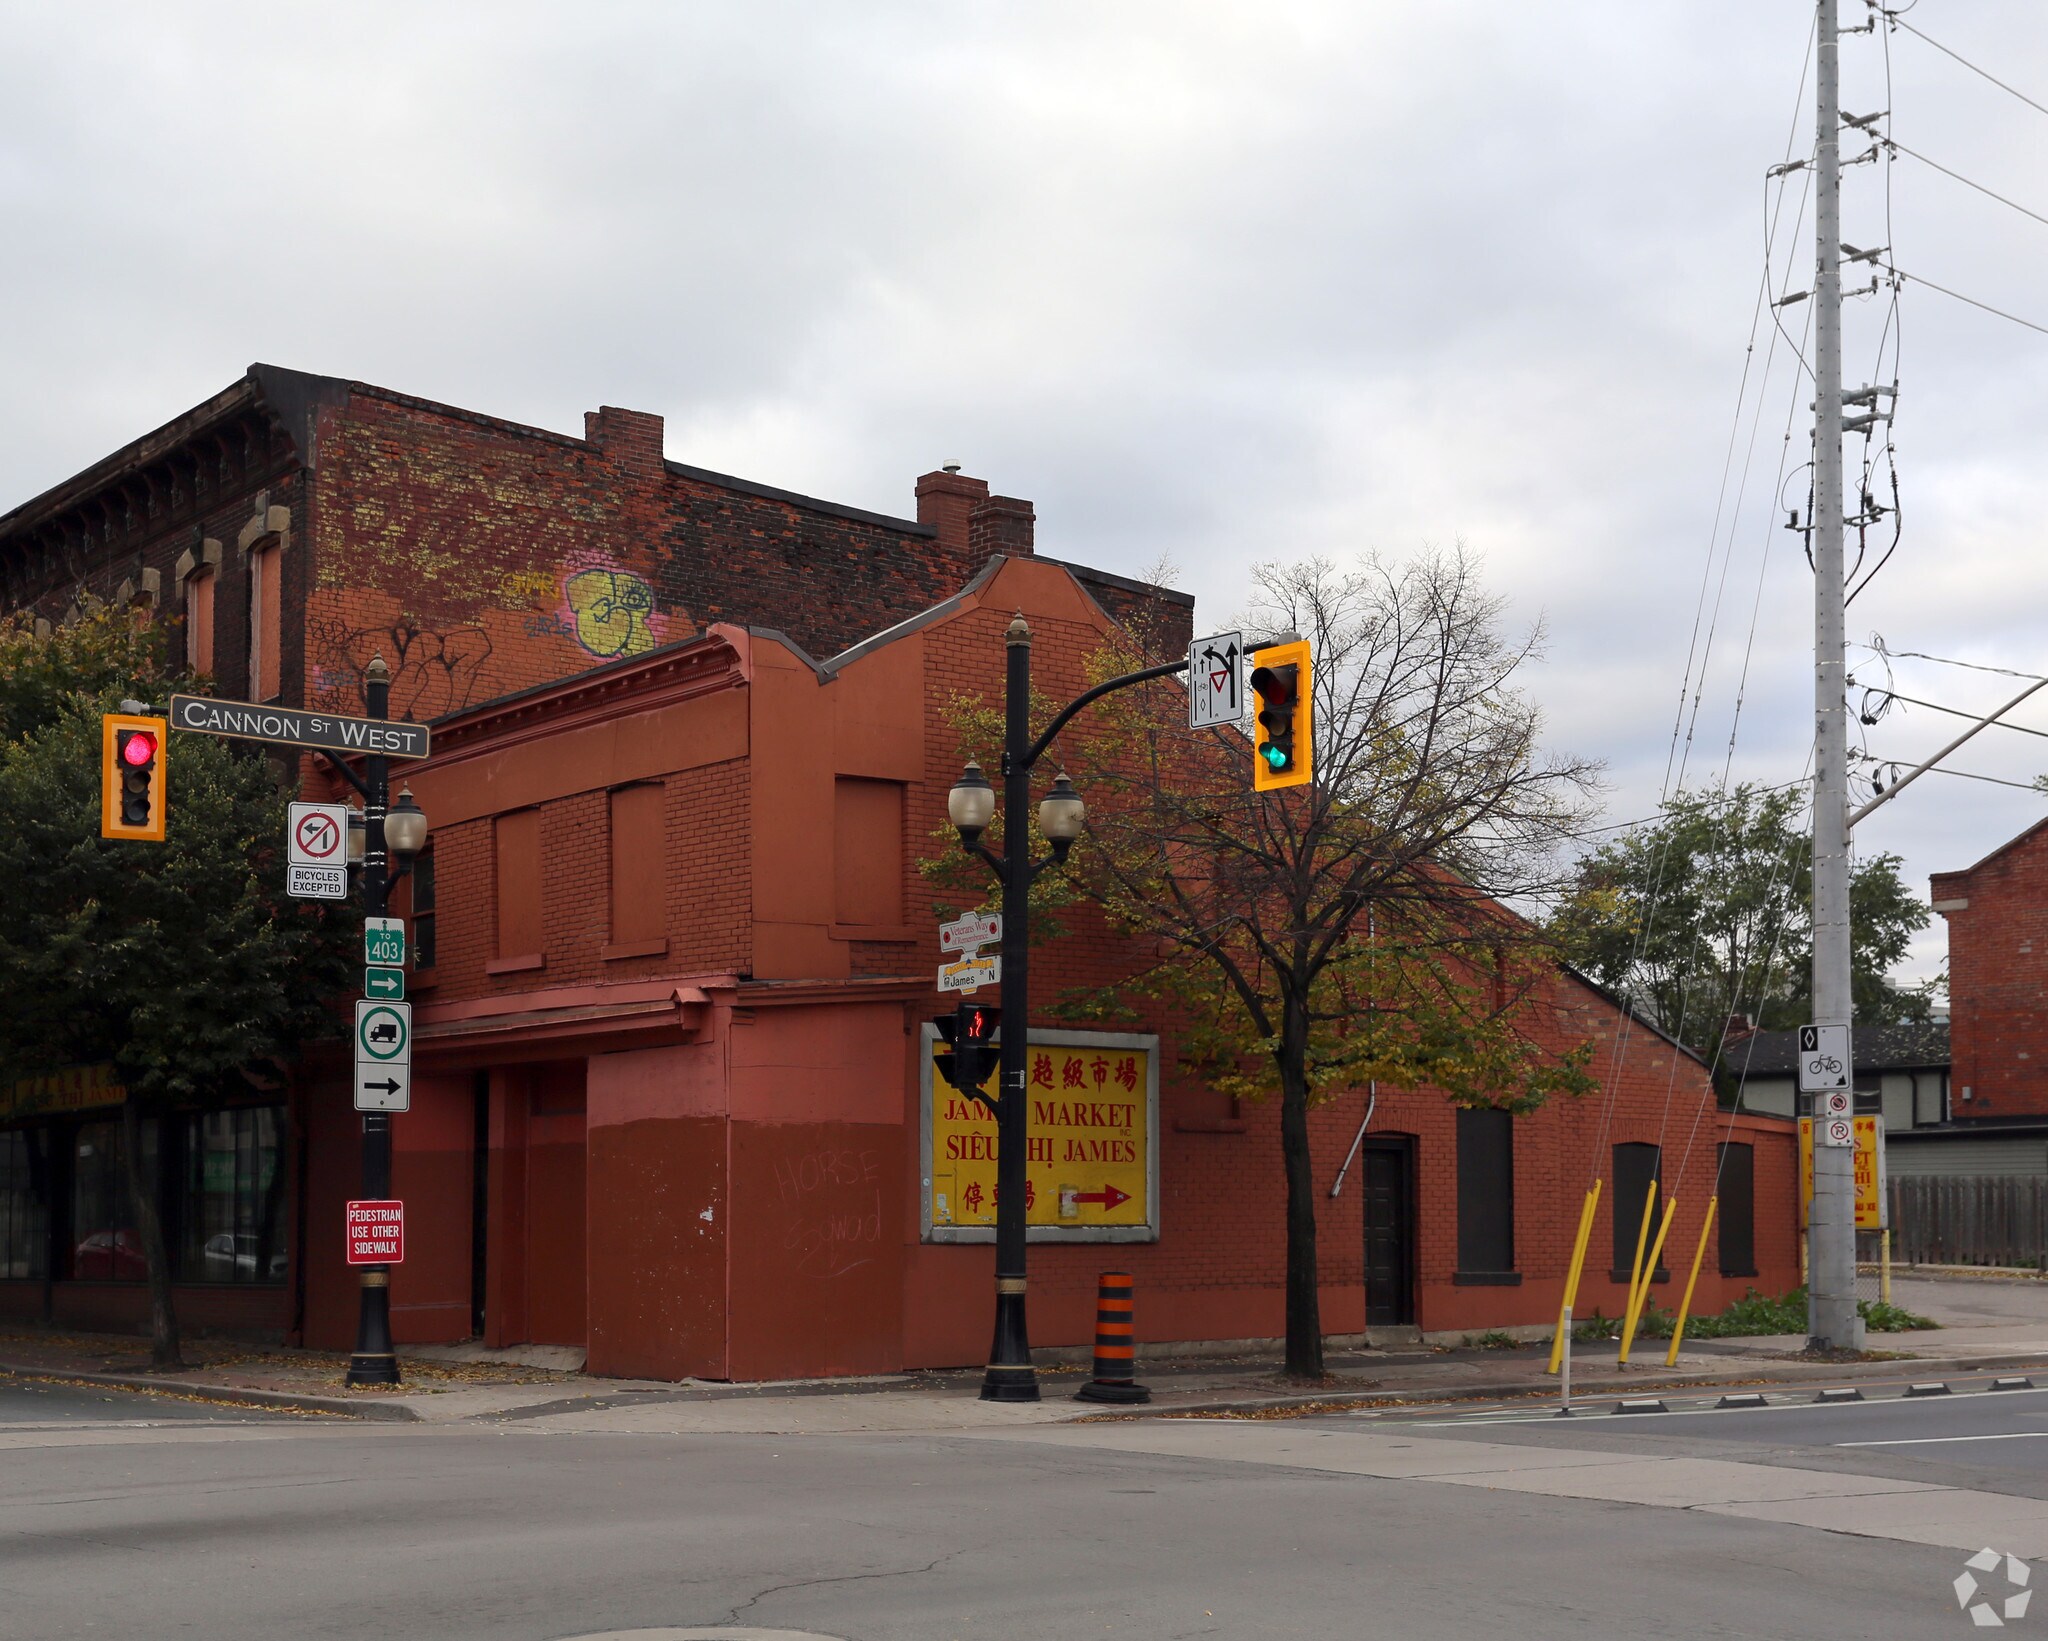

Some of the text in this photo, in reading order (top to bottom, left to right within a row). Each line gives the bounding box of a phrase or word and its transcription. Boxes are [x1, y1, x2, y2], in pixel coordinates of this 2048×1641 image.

[184, 702, 300, 739] CANNON
[339, 721, 417, 751] WEST
[295, 870, 340, 882] BICYCLES
[293, 881, 341, 893] EXCEPTED
[950, 921, 988, 936] Veterans Way
[958, 933, 989, 944] Remembrance
[371, 941, 399, 959] 403
[950, 975, 975, 988] James
[988, 969, 995, 981] N
[944, 1099, 1136, 1128] JAM MARKET
[1027, 1137, 1054, 1169] HỊ
[1063, 1139, 1136, 1163] JAMES
[350, 1209, 401, 1222] PEDESTRIAN
[352, 1225, 399, 1238] USE OTHER
[354, 1241, 397, 1254] SIDEWALK
